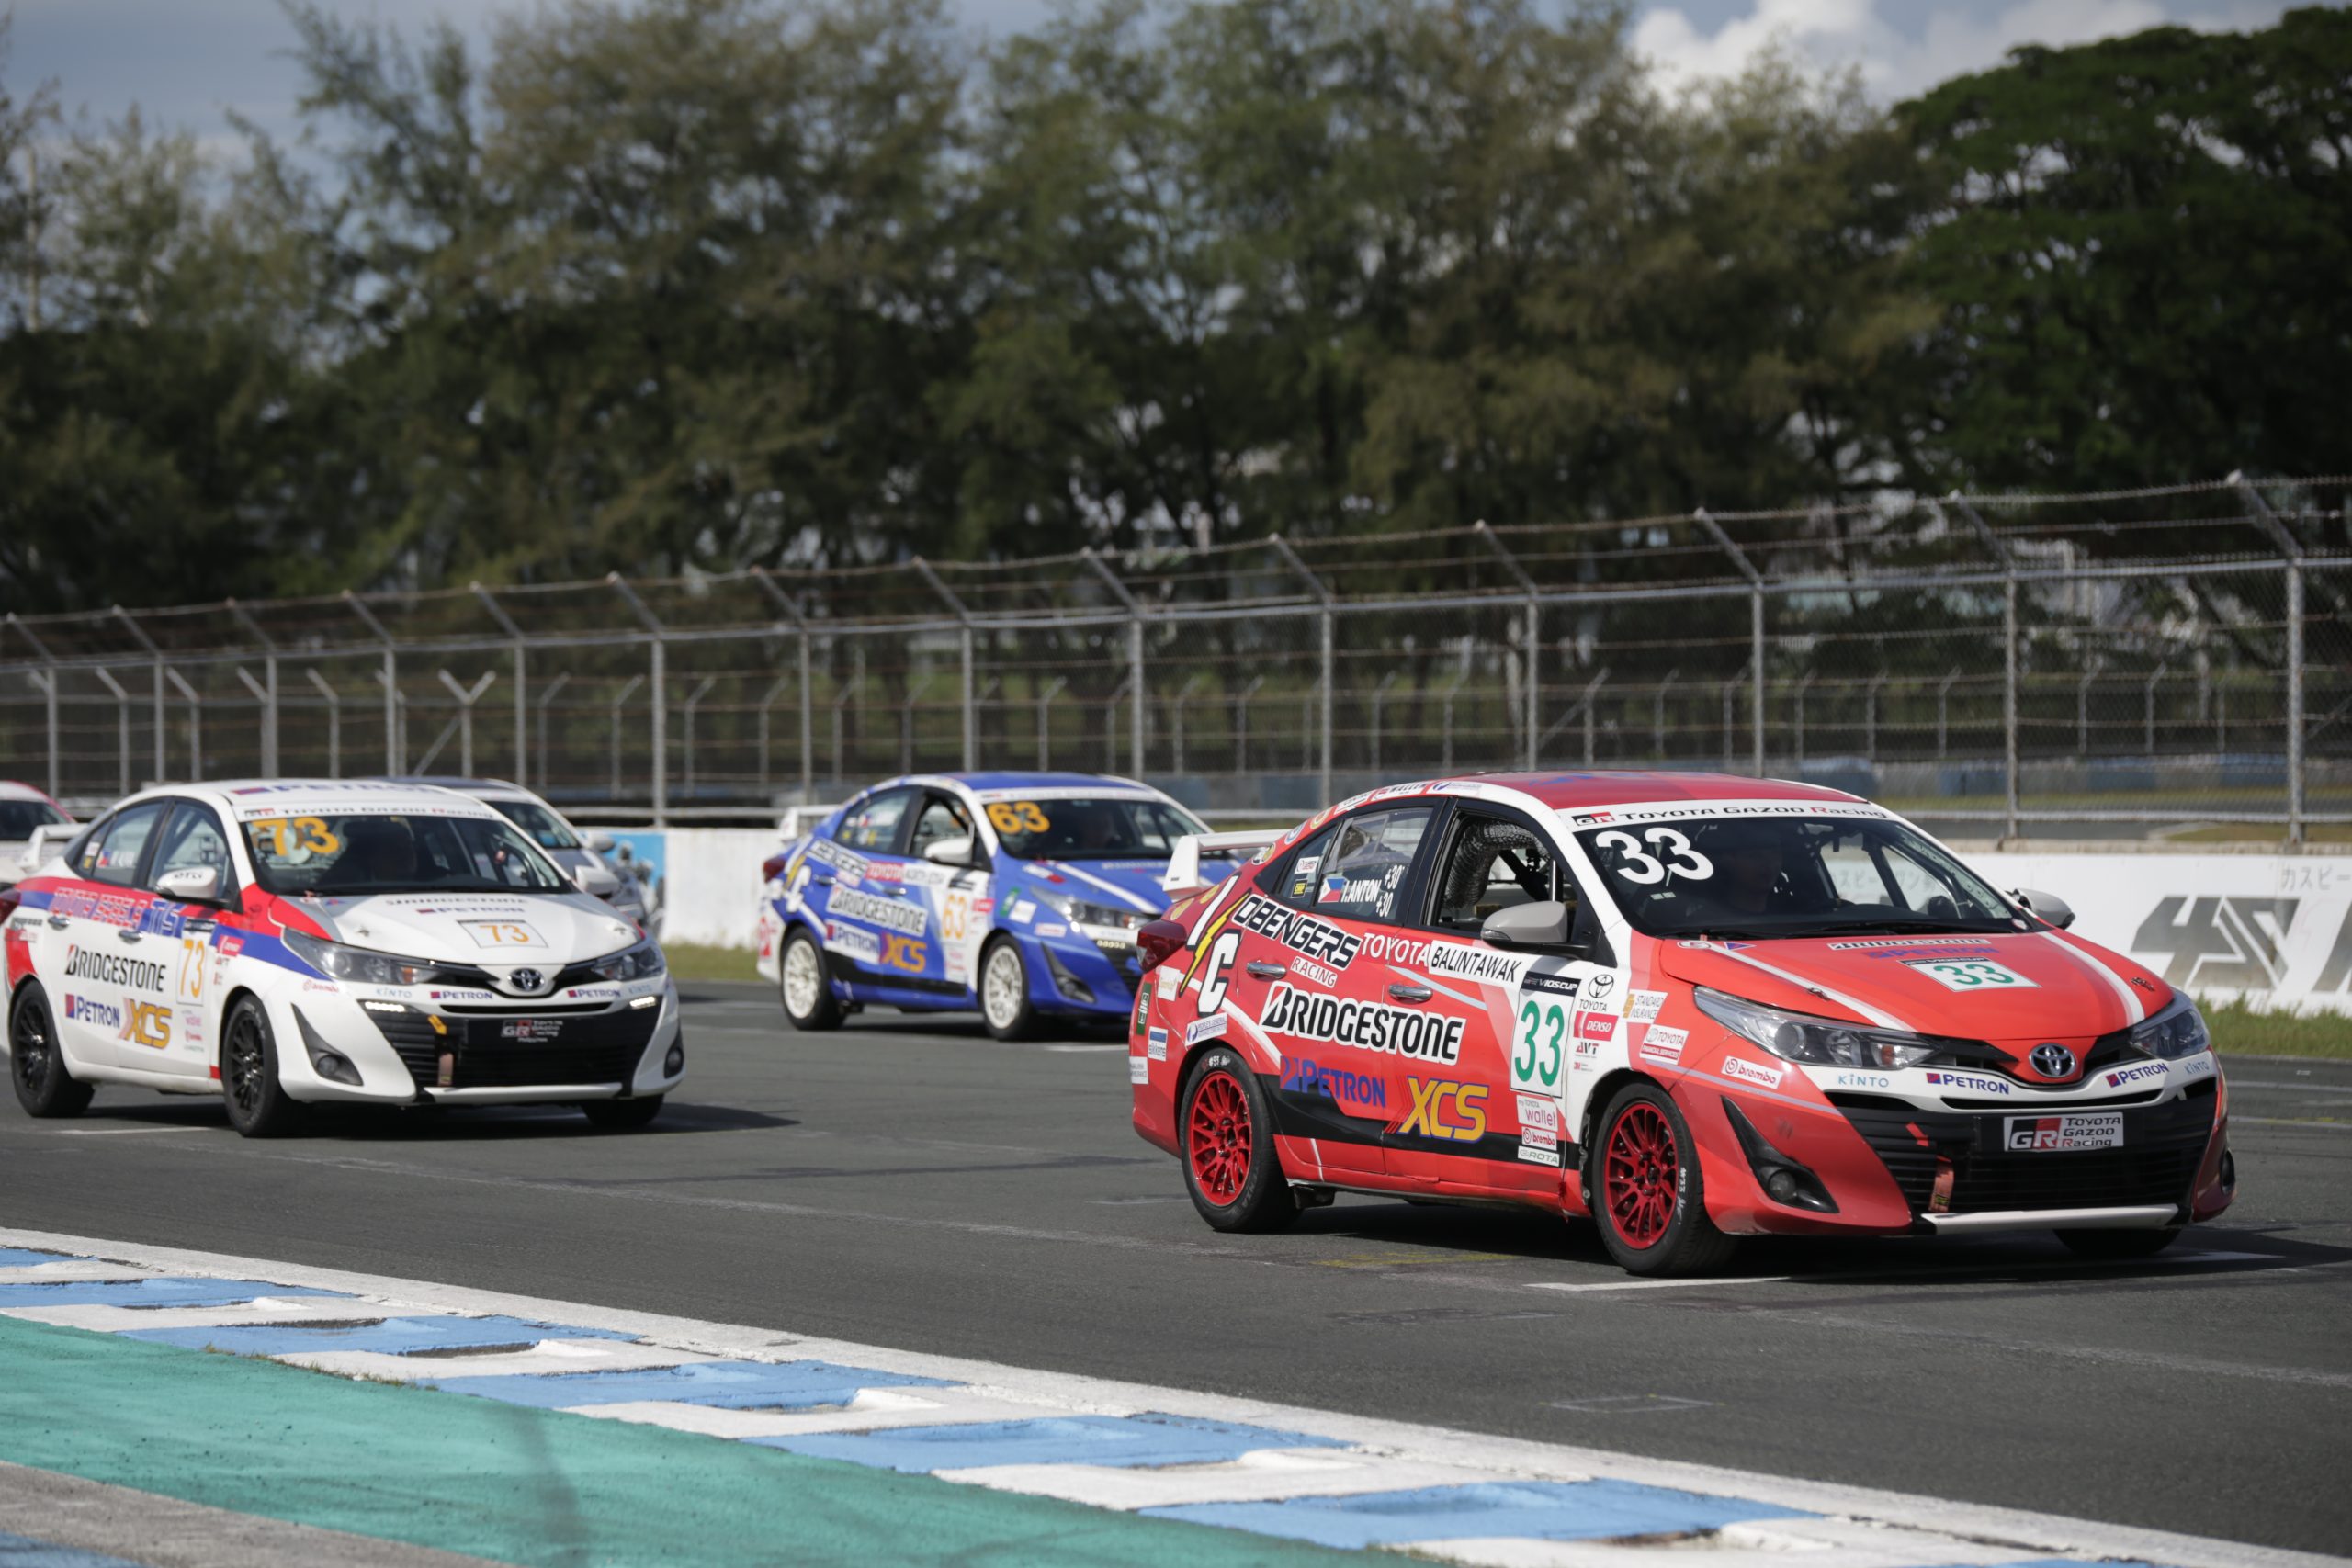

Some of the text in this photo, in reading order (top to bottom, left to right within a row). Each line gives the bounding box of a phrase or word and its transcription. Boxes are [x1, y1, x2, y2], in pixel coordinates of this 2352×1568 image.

[987, 801, 1050, 834] 63
[1619, 808, 1715, 820] TOYOTA
[1723, 806, 1804, 816] GAZOO
[1810, 807, 1888, 819] Racing
[252, 816, 340, 856] 73
[1596, 827, 1713, 885] 33
[479, 924, 531, 943] 73
[1233, 895, 1362, 970] OBENGERS
[881, 935, 927, 973] XCS
[1362, 931, 1523, 984] TOYOTA BALINTAWAK
[64, 944, 167, 993] BRIDGESTONE
[181, 939, 205, 998] 73
[1292, 958, 1337, 987] RACING
[1933, 964, 2015, 986] 33
[376, 987, 413, 998] KINTO
[442, 991, 493, 1001] PETRON
[576, 988, 622, 998] PETRON
[76, 995, 120, 1028] PETRON
[1578, 998, 1608, 1012] TOYOTA
[126, 998, 173, 1050] XCS
[1262, 987, 1463, 1061] BRIDGESTONE
[1586, 1020, 1612, 1033] DENSO
[1514, 999, 1565, 1088] 33
[1575, 1041, 1600, 1055] AVT
[1657, 1031, 1685, 1046] TOYOTA
[1301, 1061, 1386, 1108] PETRON
[1737, 1066, 1777, 1085] brembo
[1838, 1072, 1889, 1088] KINTO
[1943, 1074, 2010, 1095] PETRON
[2119, 1063, 2170, 1085] PETRON
[1397, 1075, 1490, 1144] XCS
[1525, 1108, 1556, 1128] wallet
[2064, 1127, 2115, 1136] GAZOO
[2066, 1117, 2121, 1126] TOYOTA
[1532, 1132, 1556, 1146] brembo
[2009, 1130, 2062, 1149] GR
[2062, 1137, 2112, 1148] Racing
